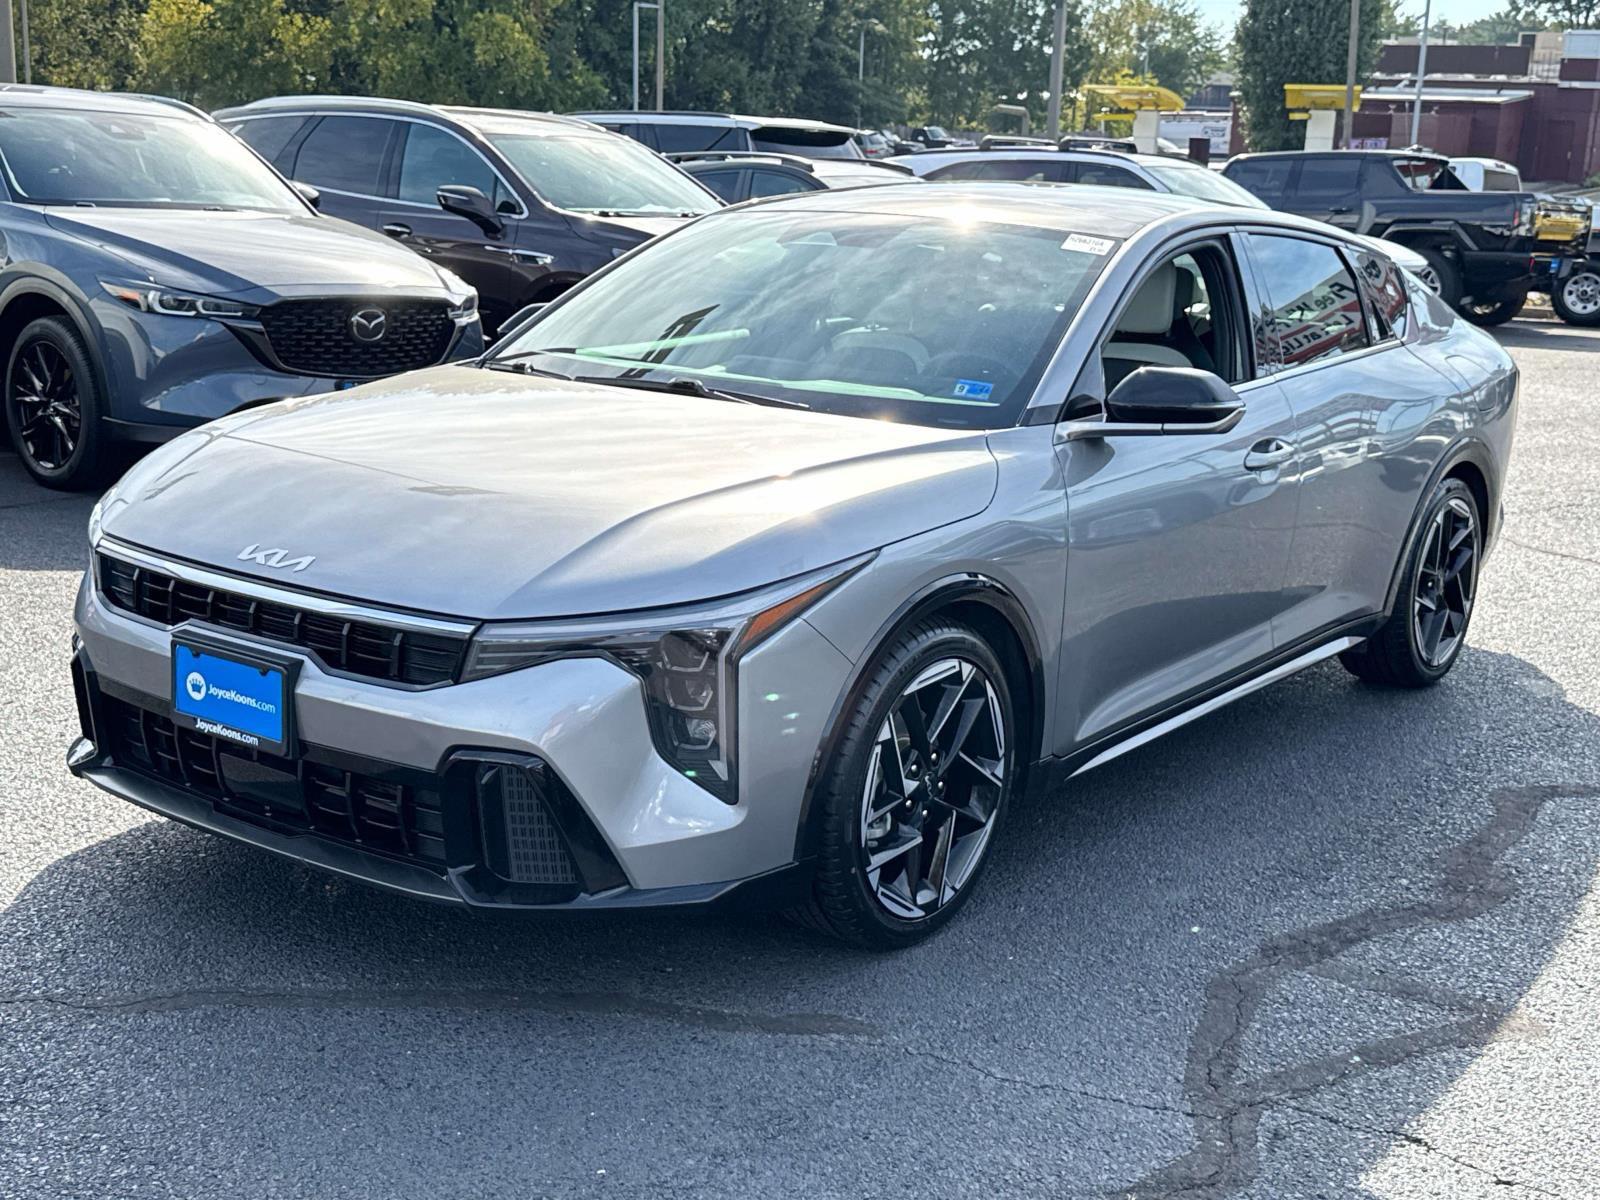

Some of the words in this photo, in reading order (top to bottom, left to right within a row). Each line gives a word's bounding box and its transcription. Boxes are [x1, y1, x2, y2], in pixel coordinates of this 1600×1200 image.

[237, 543, 316, 573] KIA
[208, 683, 276, 714] JoyceKoons.com
[195, 718, 259, 746] JoyceKoons.com
